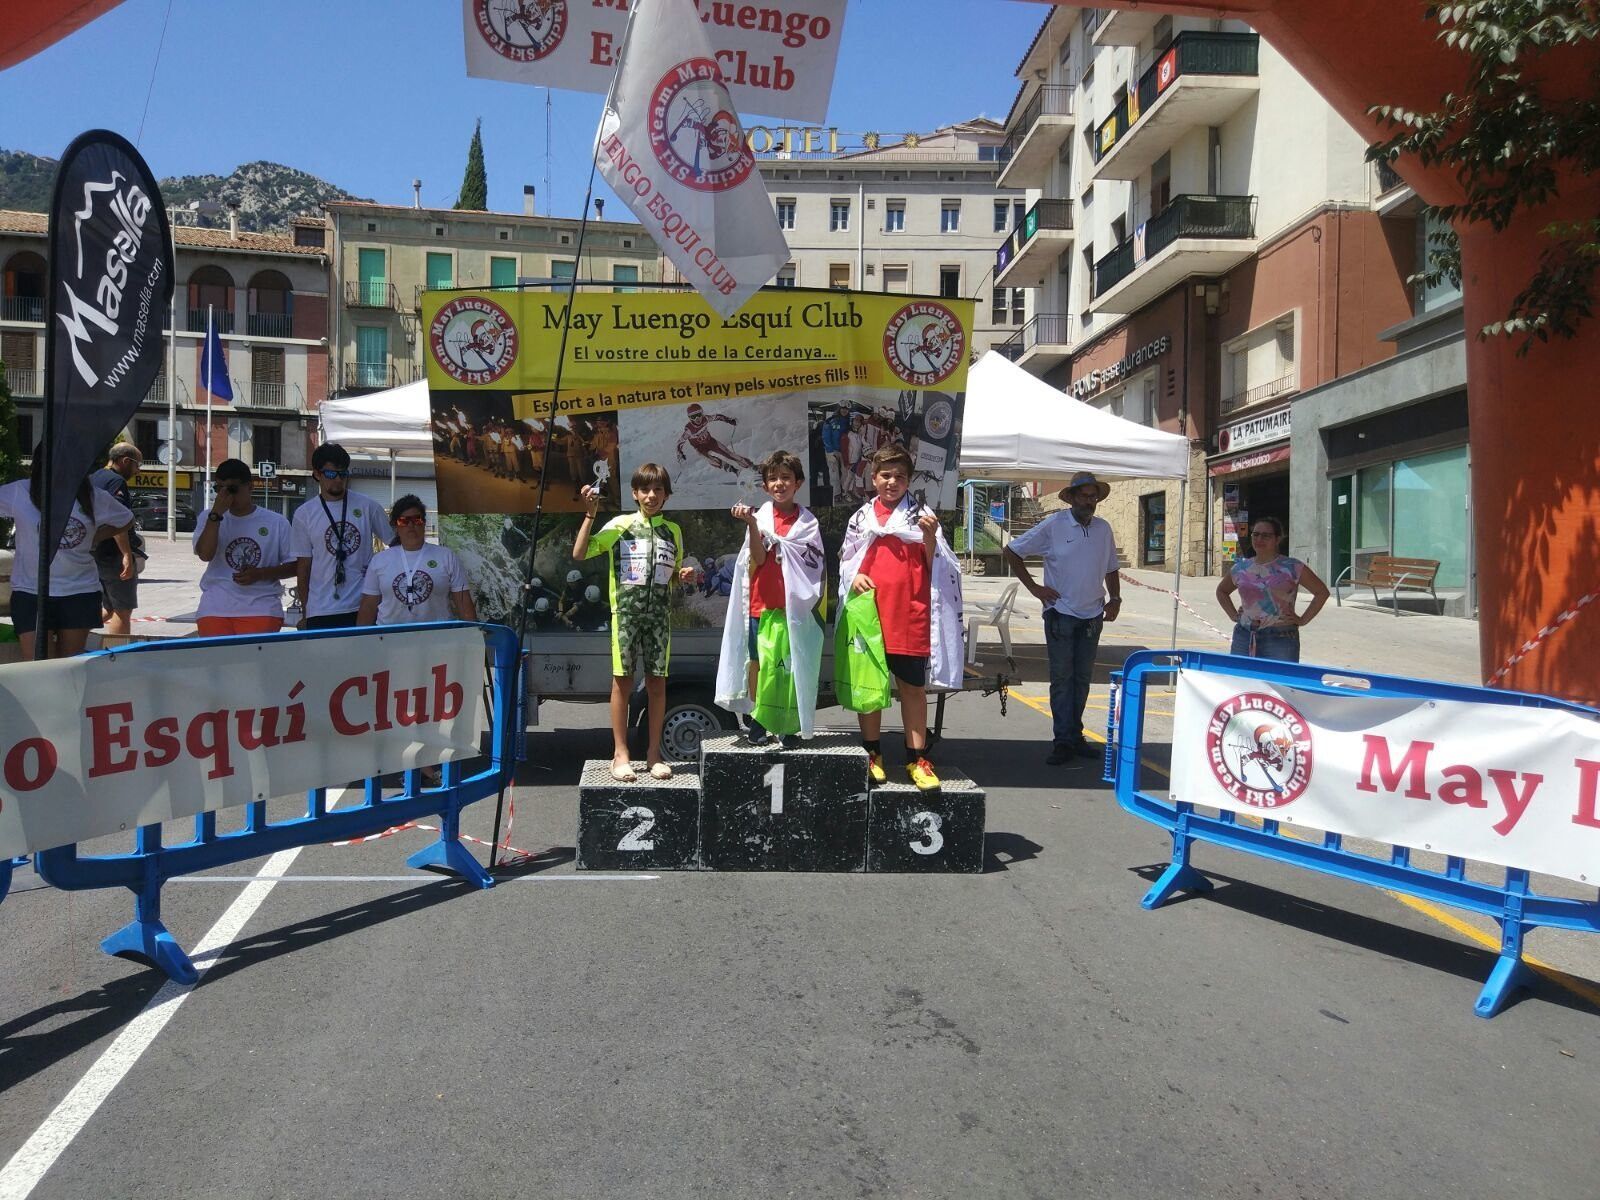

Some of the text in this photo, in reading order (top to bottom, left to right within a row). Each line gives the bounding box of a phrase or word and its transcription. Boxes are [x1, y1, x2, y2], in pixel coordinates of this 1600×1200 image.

[511, 47, 535, 61] Ski
[714, 49, 795, 91] Club
[676, 63, 715, 83] May
[747, 125, 846, 153] OTEL
[658, 148, 690, 182] Ski
[696, 153, 754, 187] Racing
[646, 192, 701, 253] ESQUI
[694, 247, 737, 295] CLUB
[55, 184, 152, 389] Masella
[104, 257, 163, 389] www.masella.com
[432, 308, 454, 336] May
[454, 300, 506, 325] Luengo
[542, 304, 603, 339] May
[612, 304, 710, 339] Luengo
[802, 302, 863, 328] Club
[886, 311, 909, 339] May
[910, 304, 955, 329] Luengo
[494, 327, 515, 375] Racing
[574, 345, 836, 361] El vostre club de la Cerdanya...
[939, 331, 962, 377] Racing
[1101, 335, 1167, 385] assegurances
[467, 371, 491, 384] Ski
[533, 397, 582, 413] Esport
[587, 397, 595, 408] a
[600, 393, 613, 406] la
[617, 389, 666, 405] natura
[670, 384, 693, 399] tot
[735, 377, 765, 396] pels
[768, 373, 821, 389] vostres
[825, 367, 850, 383] fills
[913, 373, 935, 385] Ski
[1233, 426, 1243, 441] LA
[135, 475, 164, 487] RACC
[262, 463, 273, 476] P
[3, 663, 464, 792] o Esquí Club
[1209, 703, 1235, 737] May
[1239, 695, 1303, 735] Luengo
[1281, 740, 1312, 799] Racing
[1356, 733, 1544, 837] May
[762, 763, 787, 814] 1
[1245, 789, 1276, 807] Ski
[616, 806, 655, 851] 2
[908, 811, 944, 855] 3
